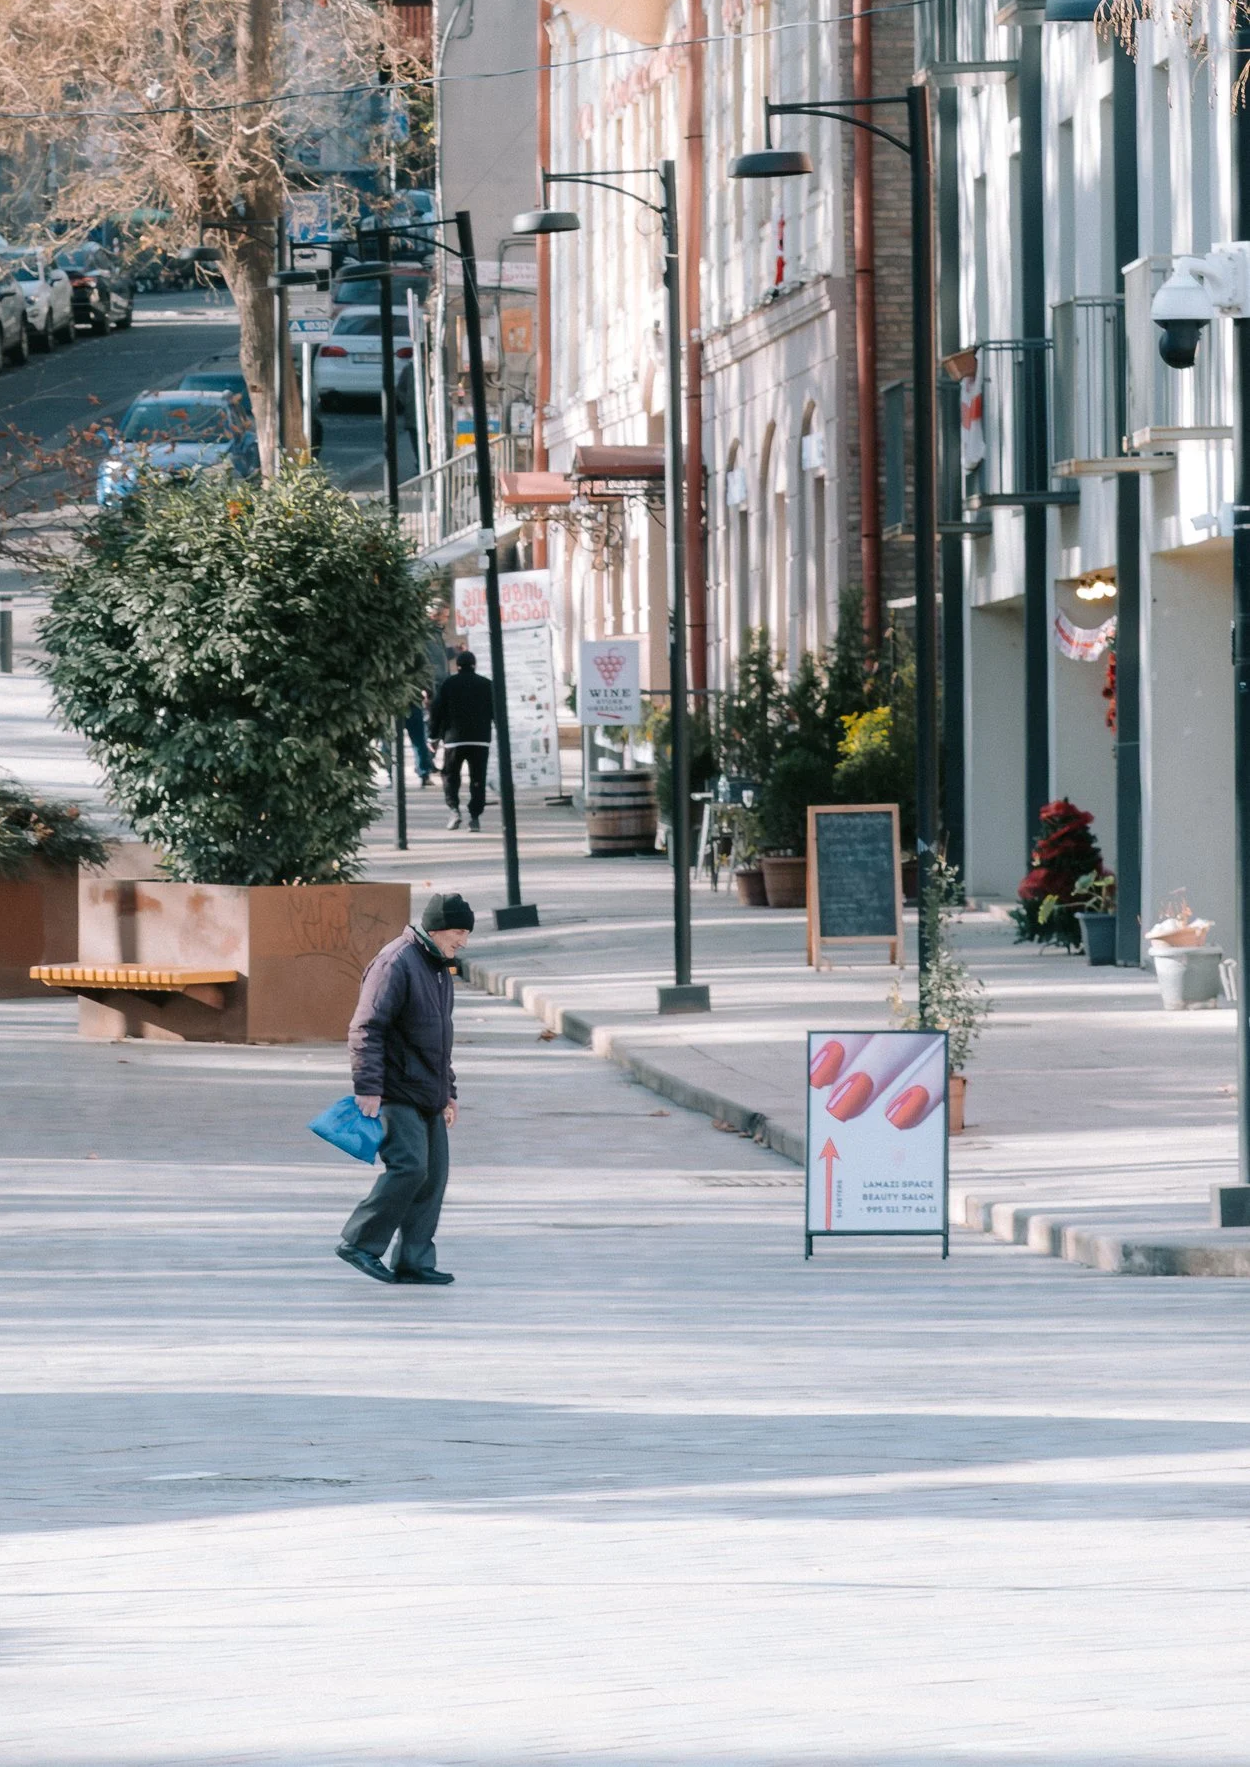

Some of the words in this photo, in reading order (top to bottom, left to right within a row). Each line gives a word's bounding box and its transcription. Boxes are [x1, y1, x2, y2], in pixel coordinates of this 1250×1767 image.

[588, 688, 632, 698] WINE
[901, 1180, 934, 1188] SPACE
[862, 1193, 899, 1201] BEAUTY
[901, 1193, 934, 1201] SALON
